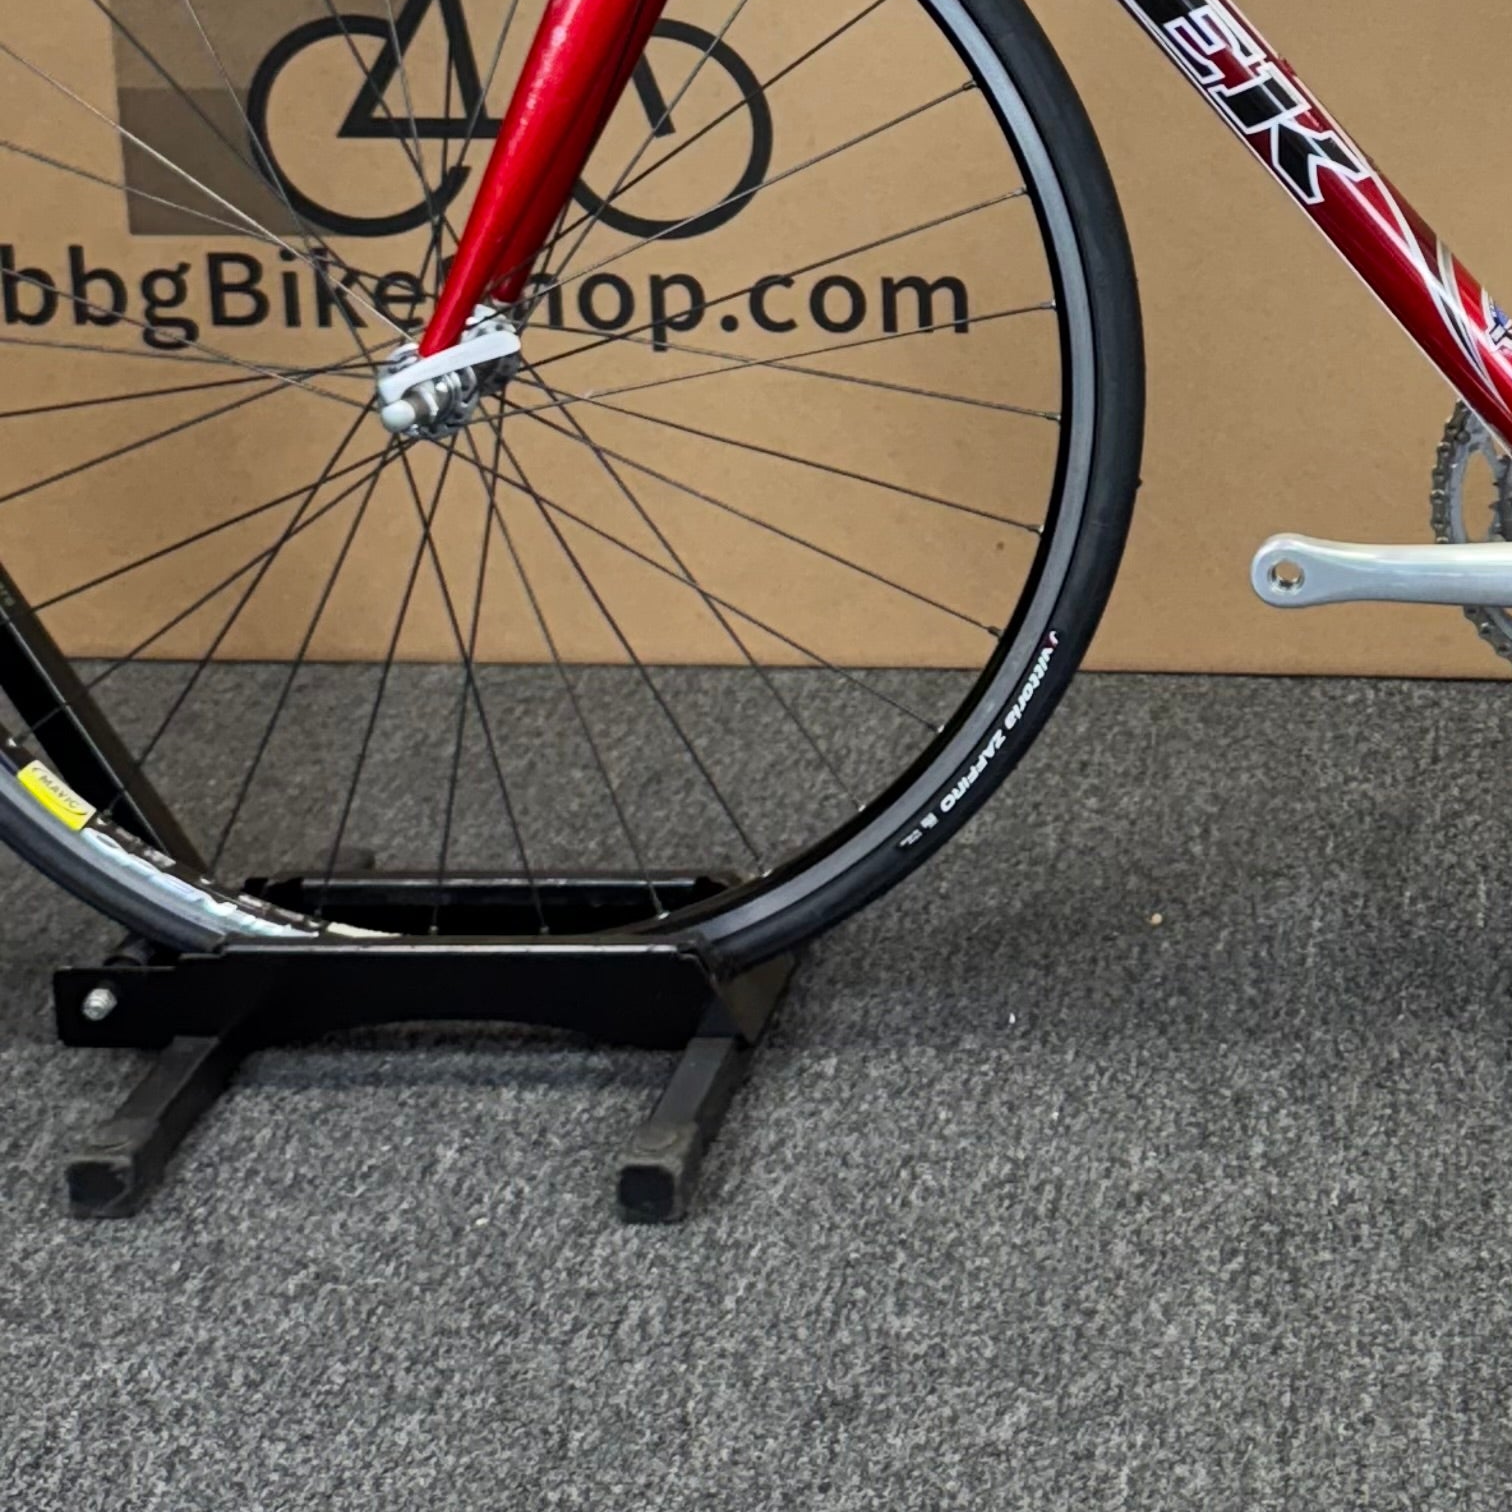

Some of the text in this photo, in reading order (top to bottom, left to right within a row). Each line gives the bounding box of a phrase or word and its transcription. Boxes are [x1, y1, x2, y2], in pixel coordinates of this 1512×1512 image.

[1, 243, 969, 352] bbgBikehop.com
[38, 774, 79, 810] MAVIC
[940, 729, 1006, 812] ZAFFIRO
